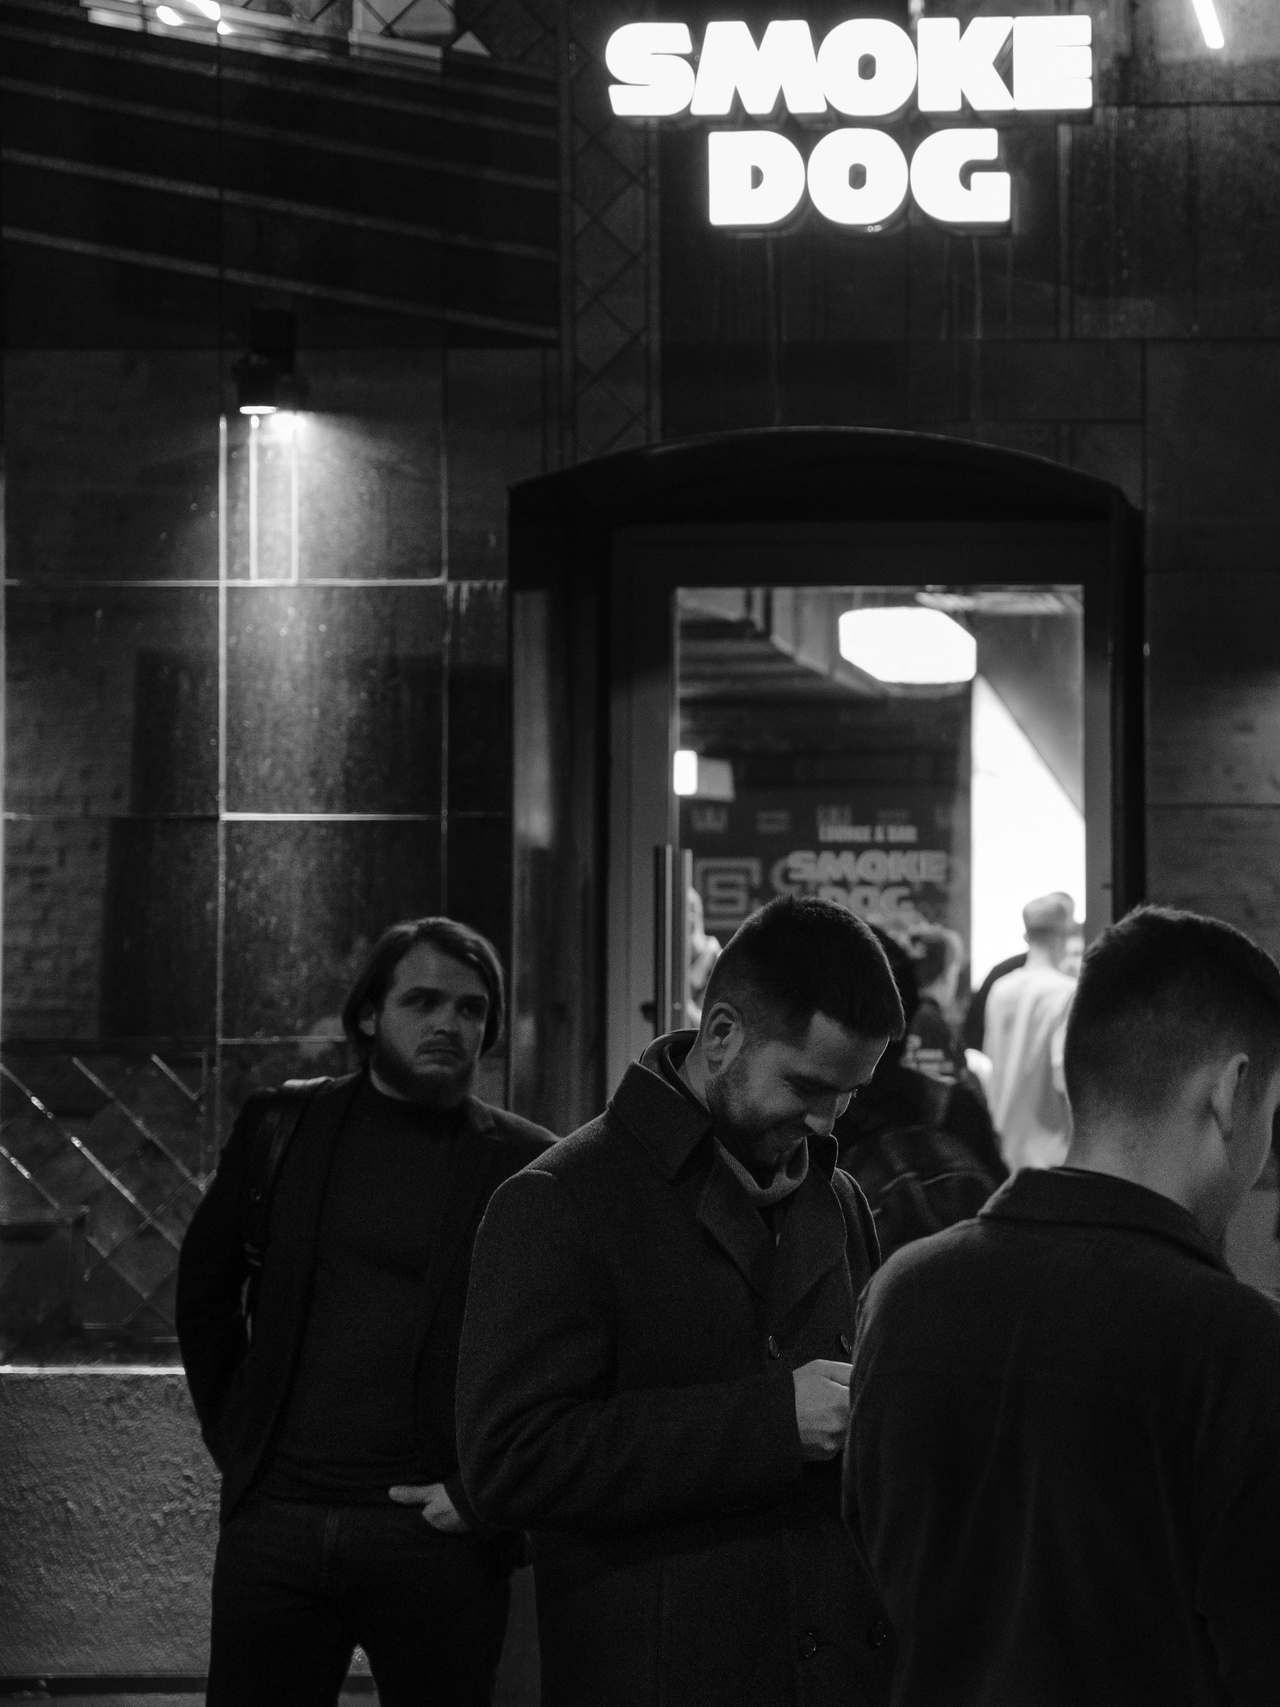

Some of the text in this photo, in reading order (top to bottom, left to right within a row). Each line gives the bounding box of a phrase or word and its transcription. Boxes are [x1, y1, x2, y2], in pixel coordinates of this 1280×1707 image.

[605, 15, 1093, 116] SMOKE
[708, 128, 1011, 226] DOG
[787, 850, 949, 883] SMOKE
